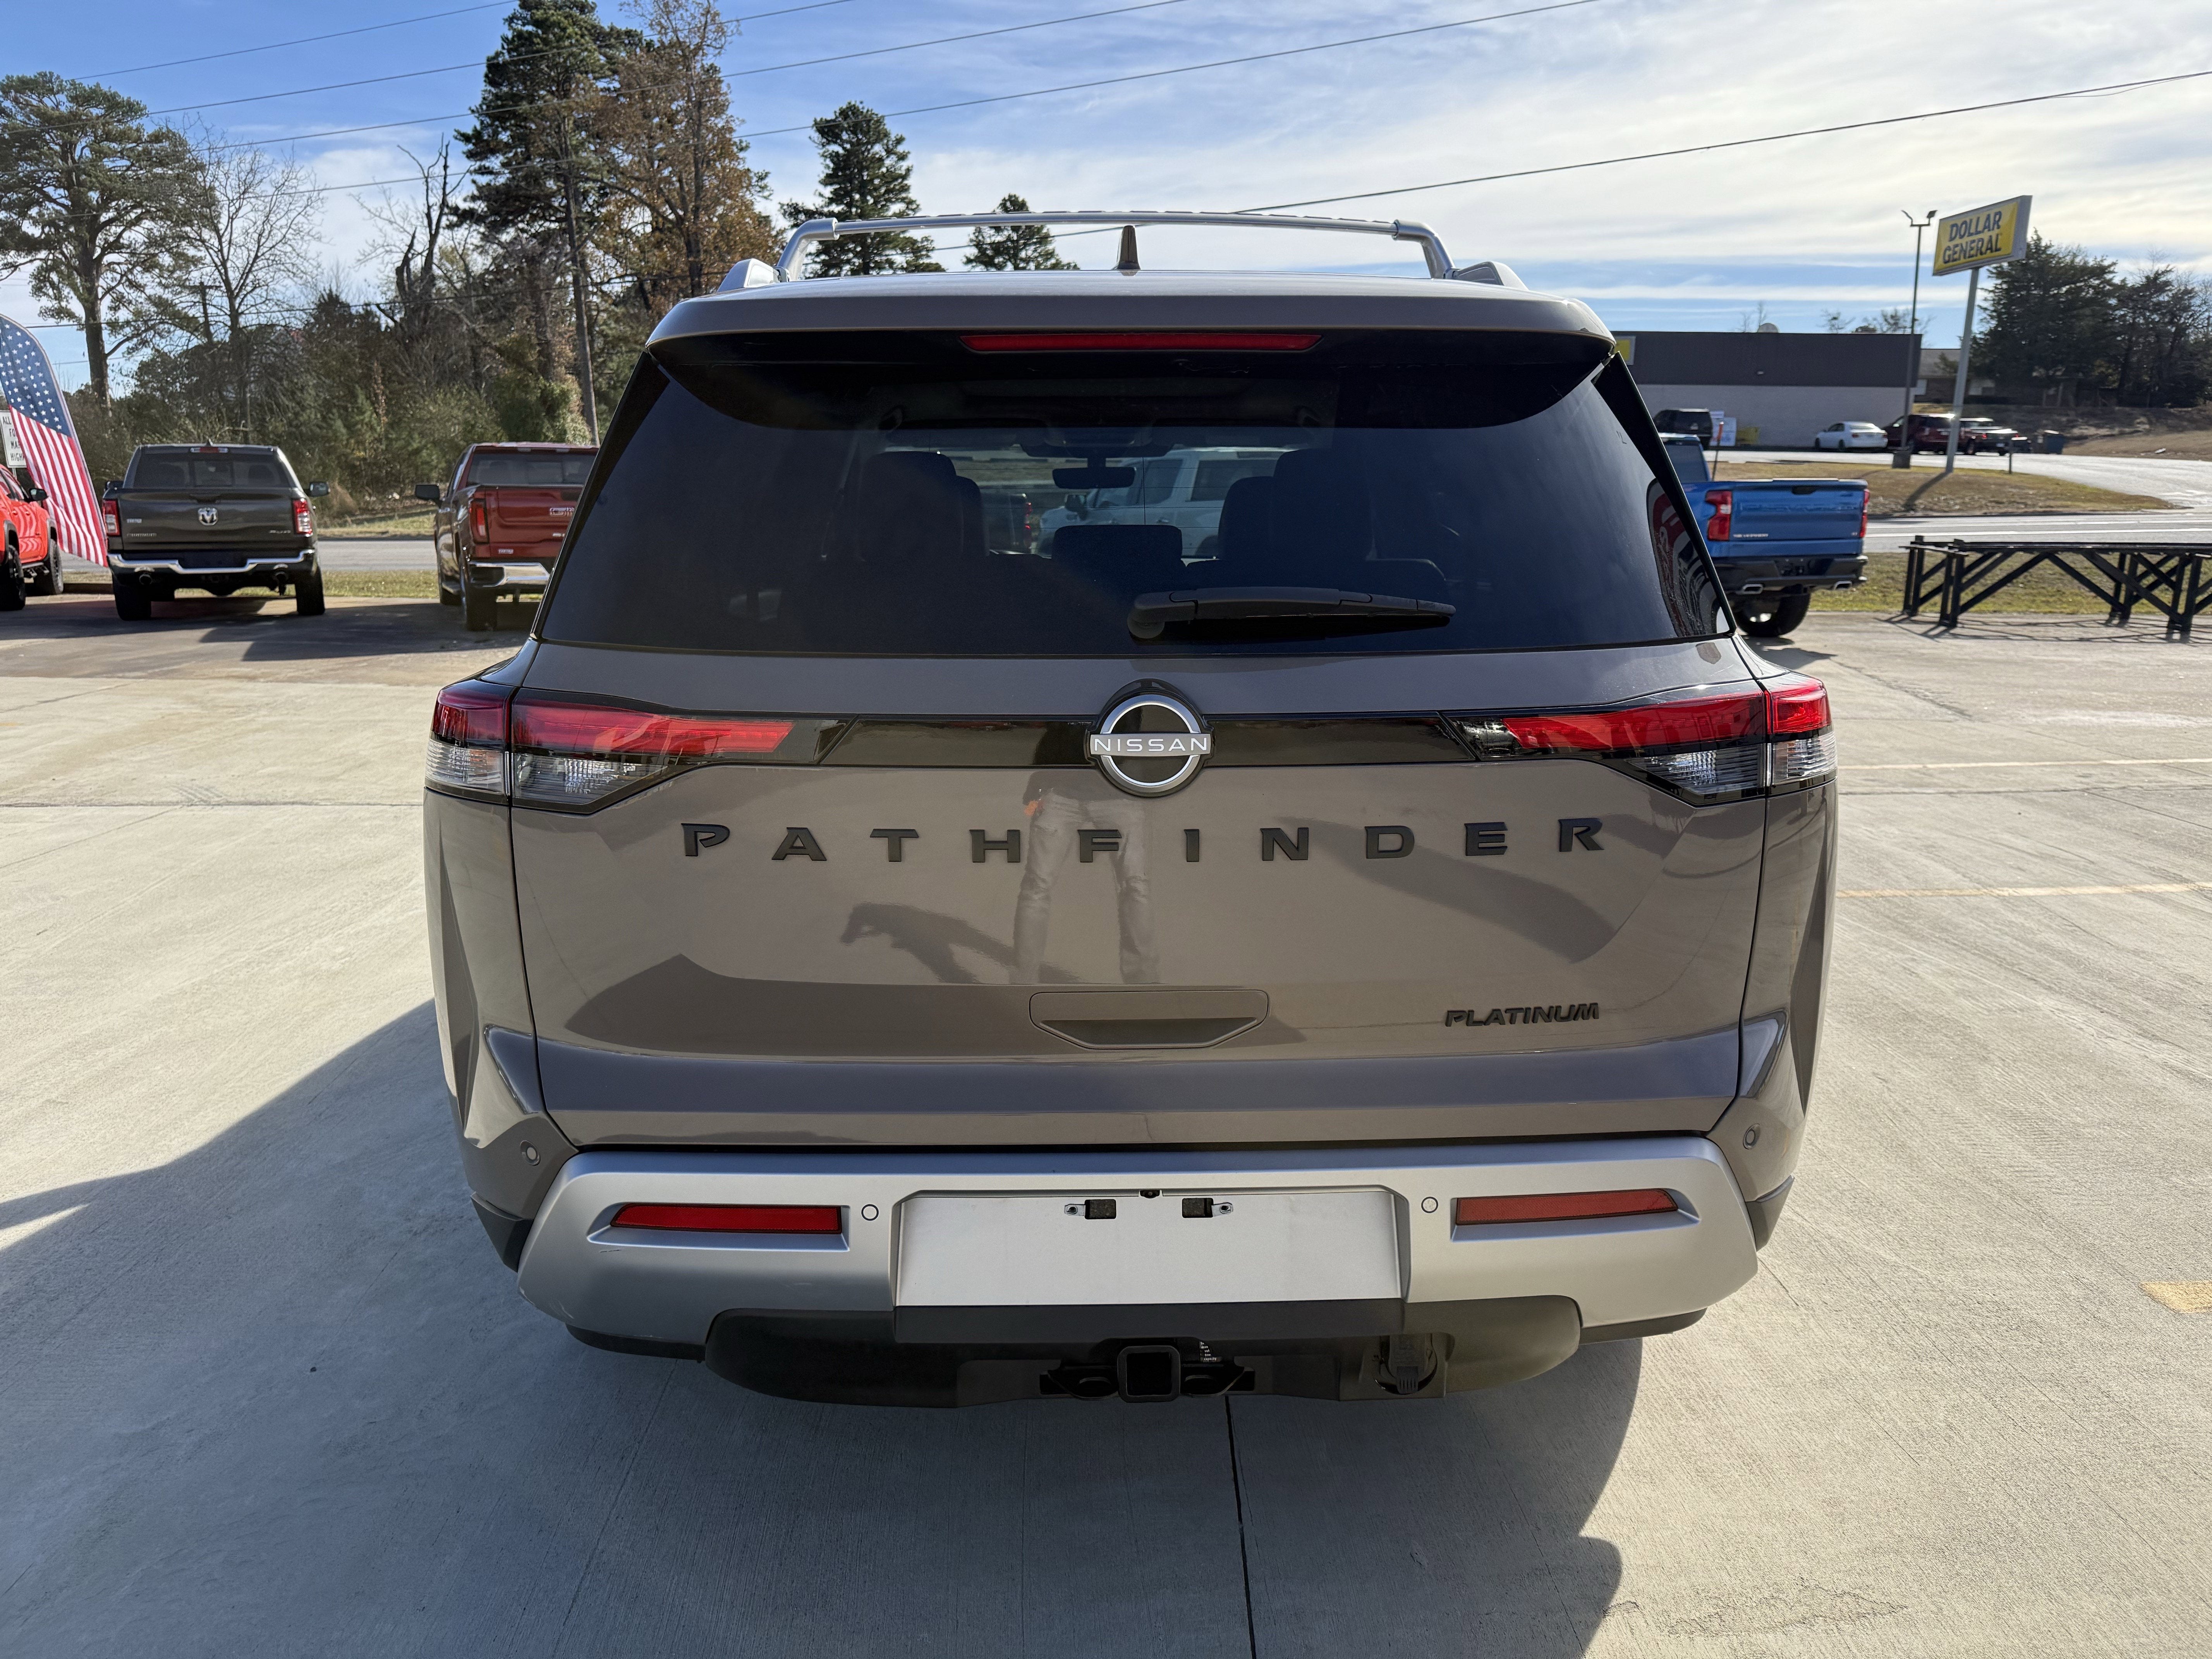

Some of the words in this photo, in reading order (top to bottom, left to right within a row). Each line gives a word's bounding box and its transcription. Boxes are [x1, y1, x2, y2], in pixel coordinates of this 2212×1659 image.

[1948, 211, 2002, 242] DOLLAR
[1942, 234, 2002, 264] GENERAL
[3, 416, 12, 425] ALL
[10, 453, 25, 462] HIGH
[1094, 737, 1207, 752] NISSAN
[681, 817, 1605, 863] PATHFINDER
[1445, 1002, 1600, 1027] PLATINUM
